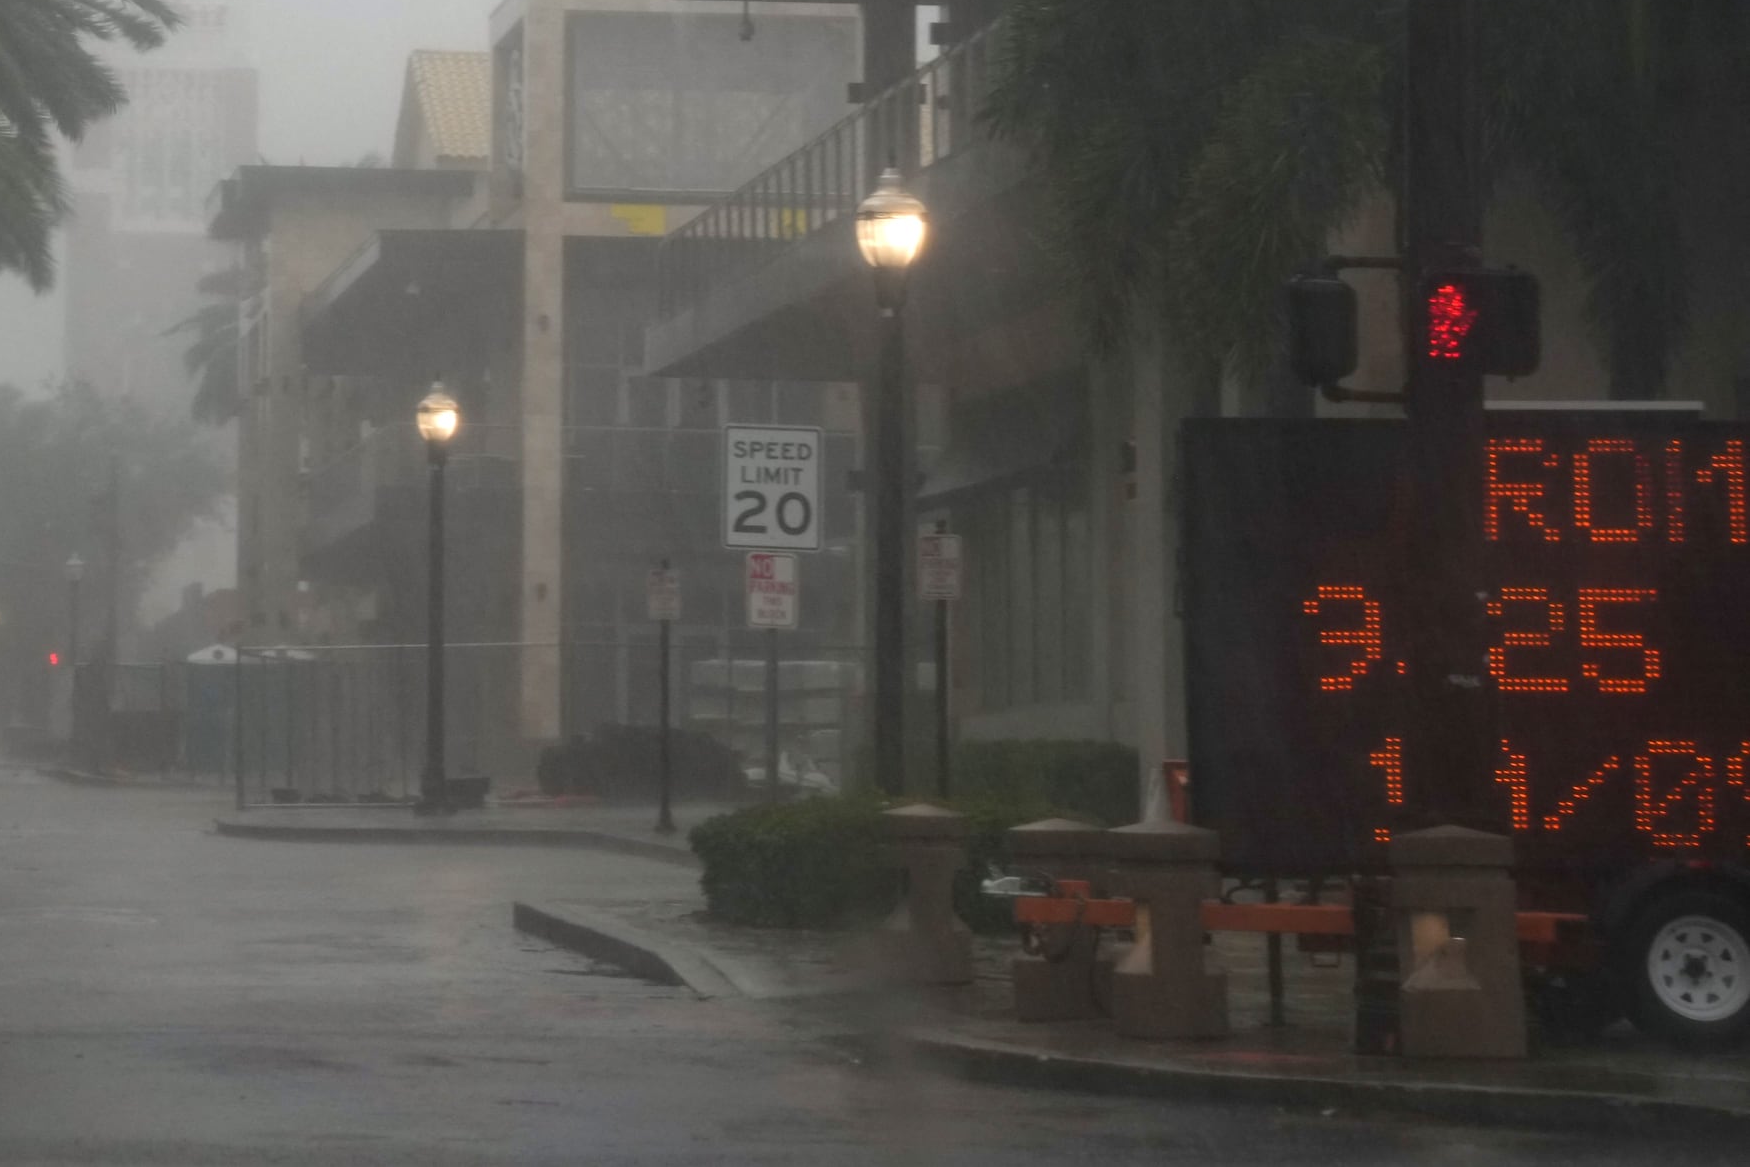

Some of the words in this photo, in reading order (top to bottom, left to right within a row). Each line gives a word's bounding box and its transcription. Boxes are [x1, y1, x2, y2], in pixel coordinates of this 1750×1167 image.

[732, 440, 812, 461] SPEED
[741, 466, 803, 485] LIMIT
[732, 490, 812, 536] 20
